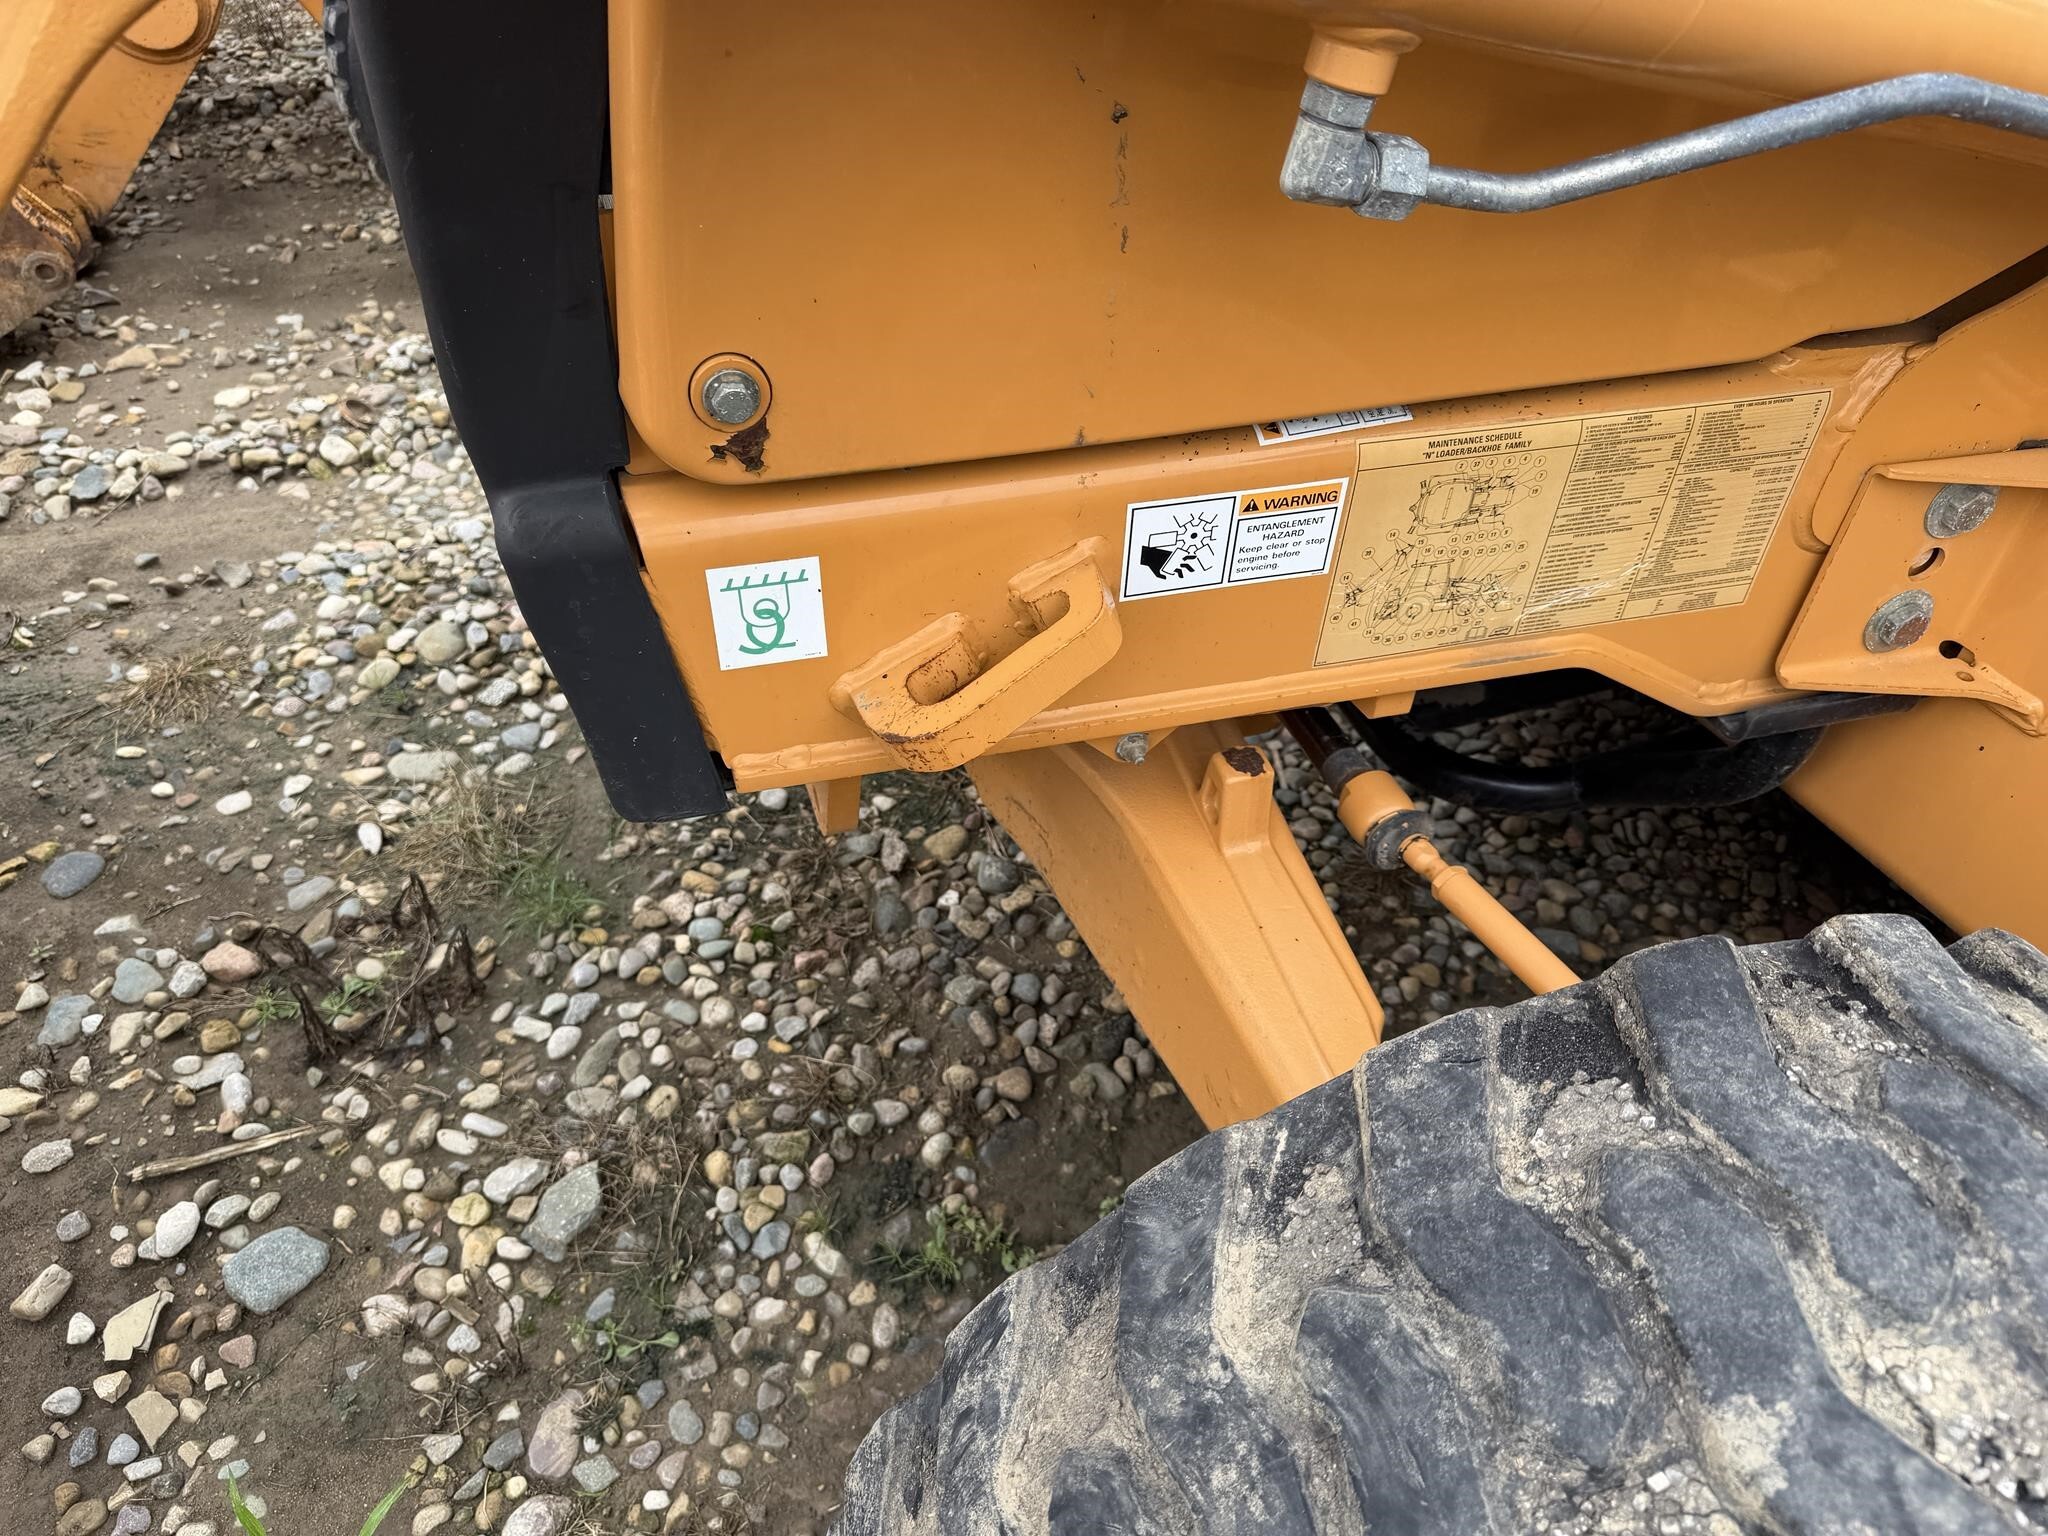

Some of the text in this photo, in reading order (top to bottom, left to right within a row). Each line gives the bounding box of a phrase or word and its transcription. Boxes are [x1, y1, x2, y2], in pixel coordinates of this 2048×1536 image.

[1428, 431, 1523, 449] MAINTENANCE SCHEDULE
[1436, 444, 1502, 458] LOADER/BACKHOE
[1504, 440, 1533, 450] FAMILY
[1263, 490, 1338, 510] WARNING
[1247, 516, 1326, 533] ENTANGLEMENT
[1262, 529, 1305, 541] HAZARD
[1238, 545, 1262, 554] Keep
[1266, 542, 1289, 551] clear
[1305, 537, 1326, 546] stop
[1237, 550, 1301, 564] engine before
[1236, 562, 1280, 574] servicing.
